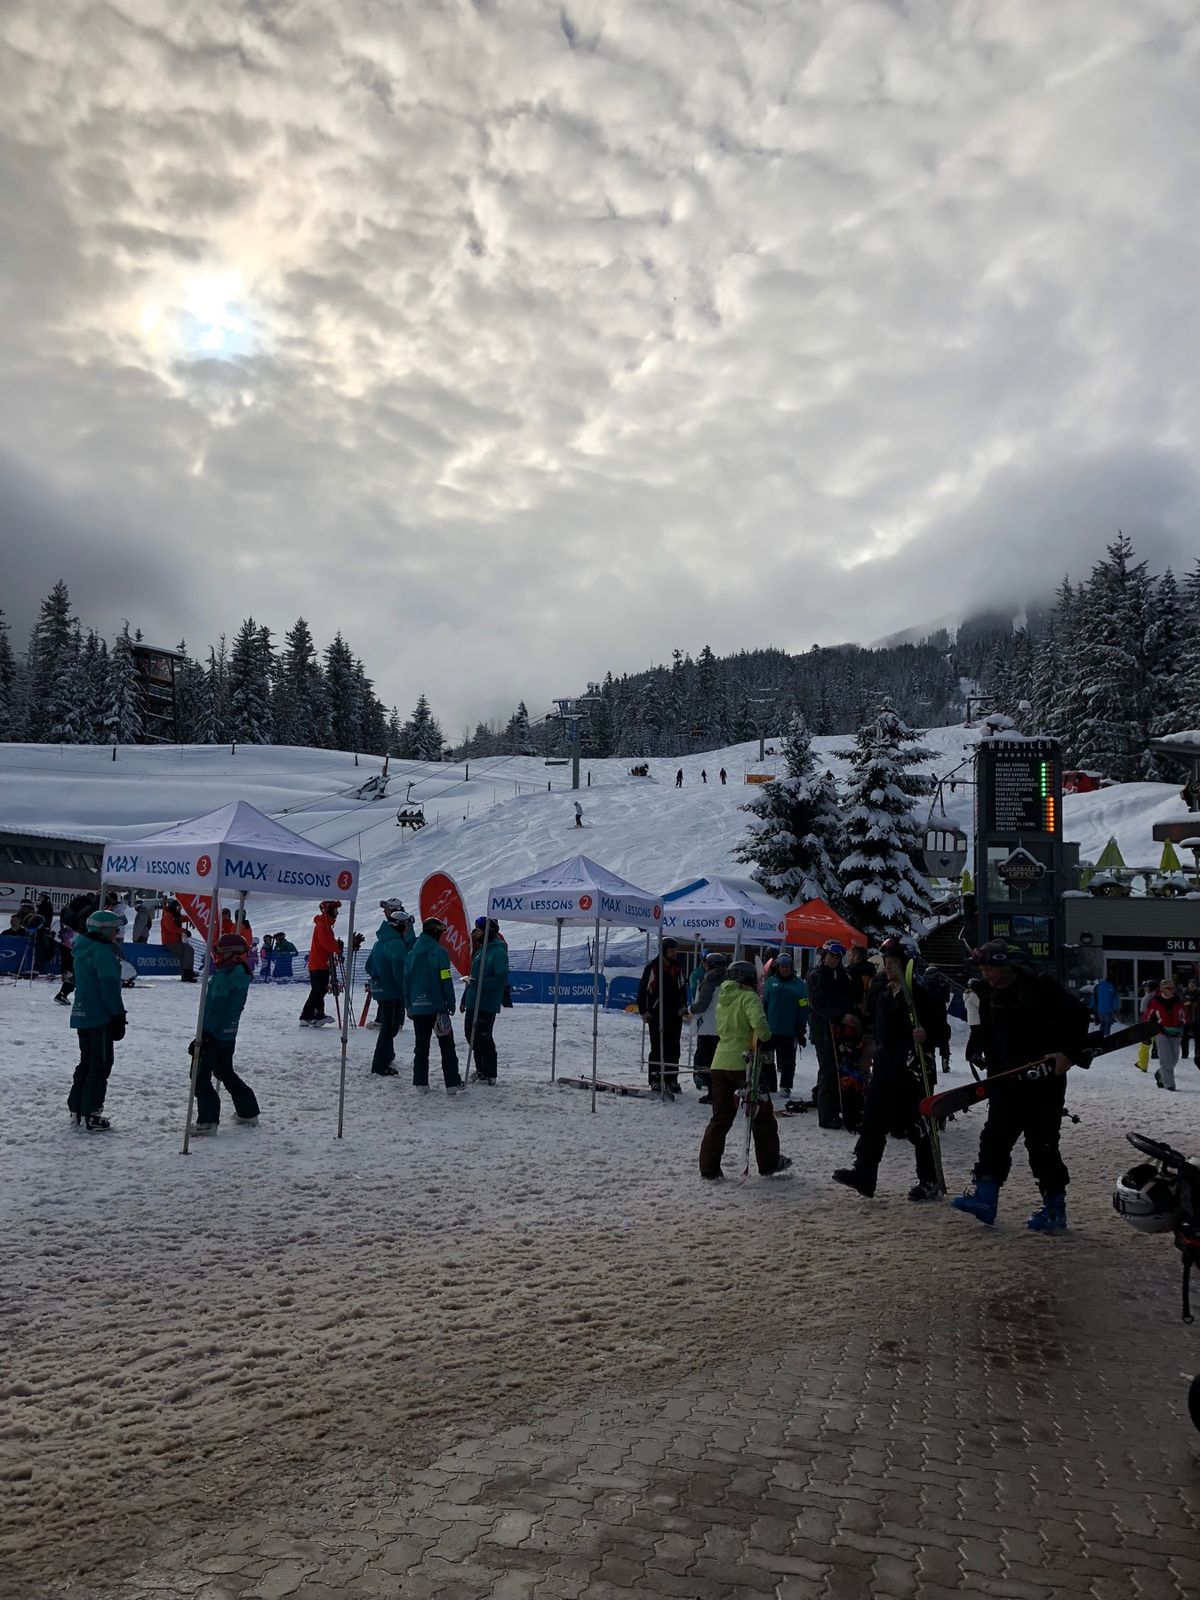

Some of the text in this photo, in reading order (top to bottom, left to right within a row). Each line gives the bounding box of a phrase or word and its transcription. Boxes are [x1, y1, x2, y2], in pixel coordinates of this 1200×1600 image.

[988, 741, 1052, 749] WHISTLER
[146, 860, 191, 875] LESSONS
[277, 870, 331, 887] LESSONS
[530, 900, 574, 910] LESSONS
[625, 904, 651, 918] LESSONS
[682, 919, 720, 928] LESSONS
[1032, 942, 1049, 955] GLC
[1167, 940, 1196, 950] SKI &
